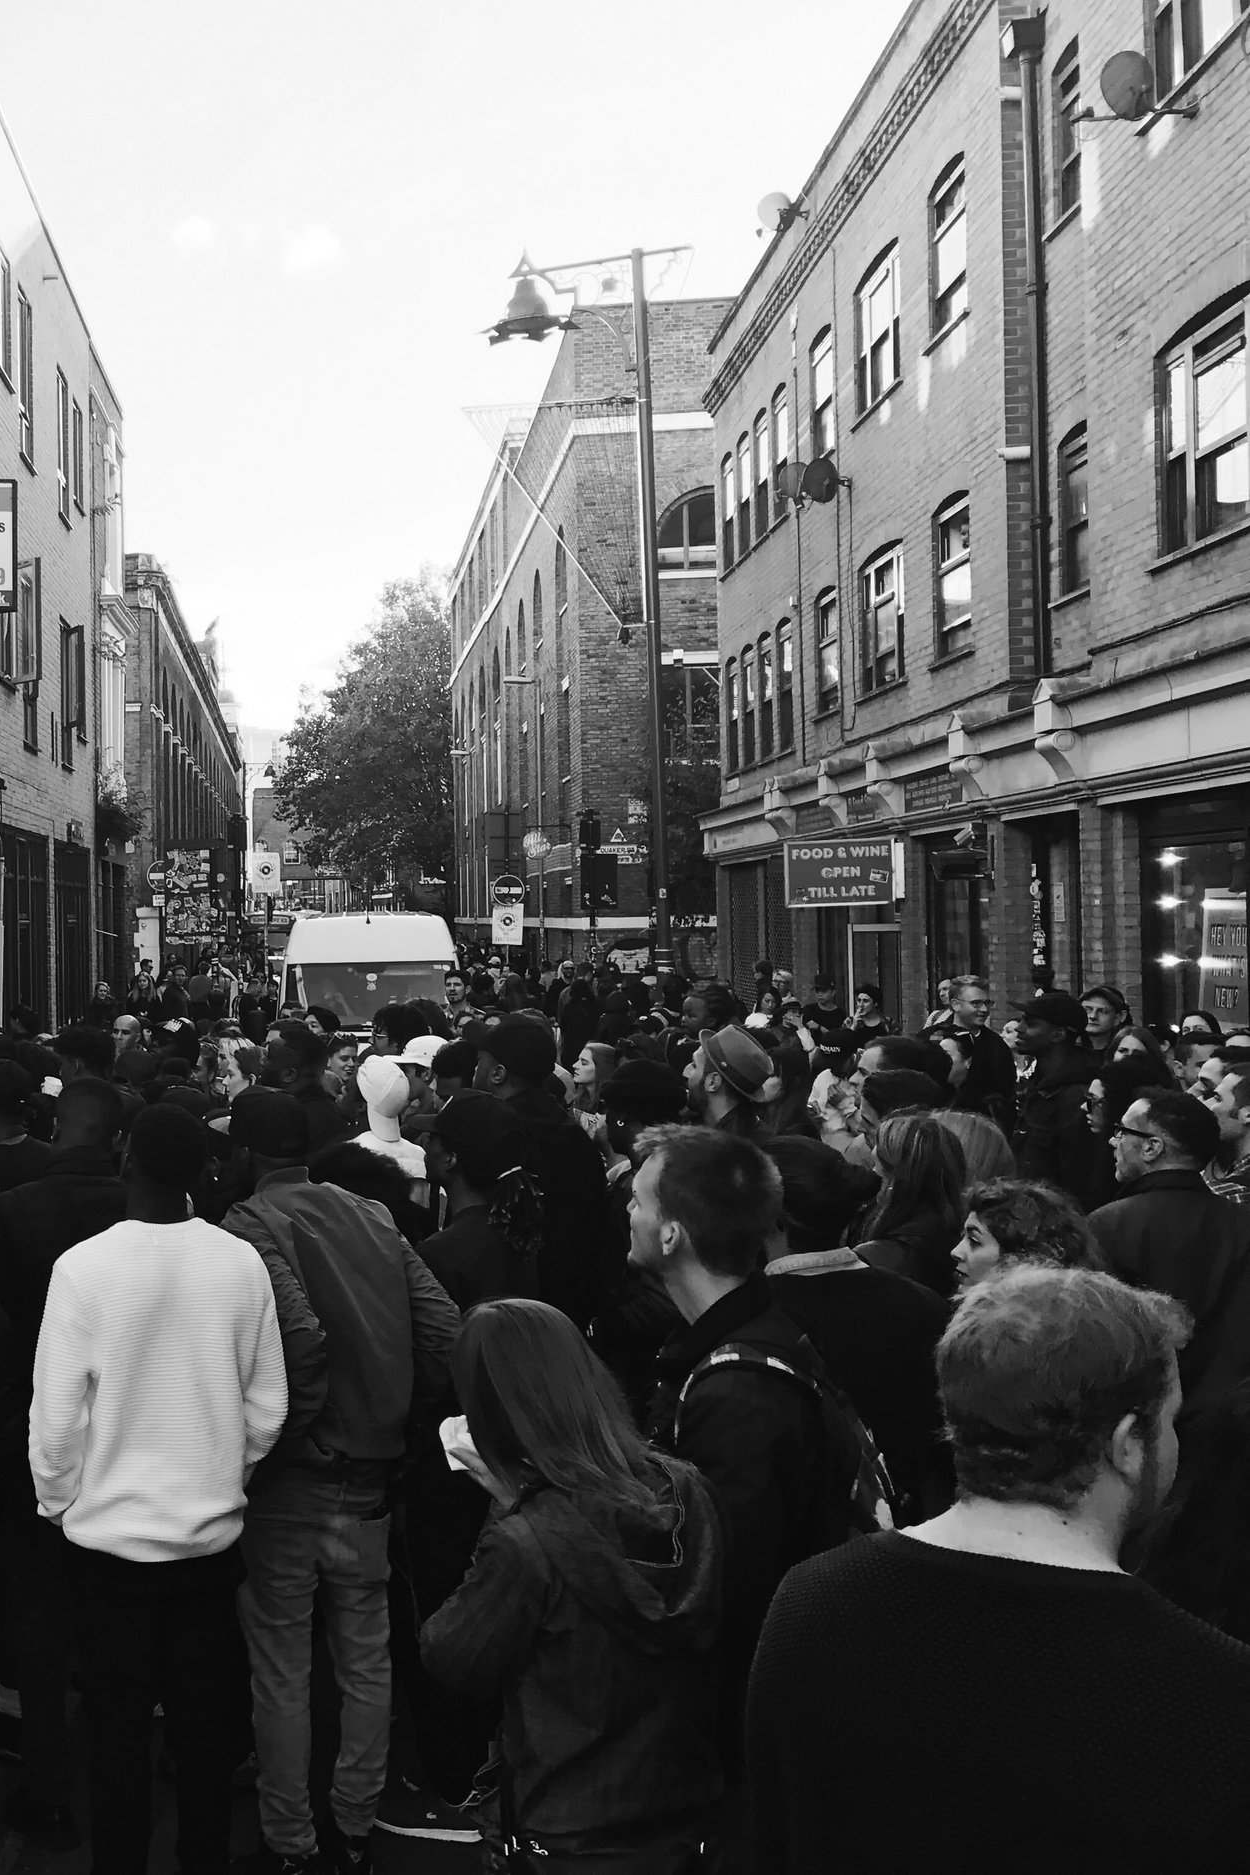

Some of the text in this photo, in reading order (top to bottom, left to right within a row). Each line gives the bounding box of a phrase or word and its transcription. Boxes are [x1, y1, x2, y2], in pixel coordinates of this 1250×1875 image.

[791, 845, 889, 860] FOOD & WINE
[820, 866, 862, 878] OPEN
[807, 885, 877, 898] TILL LATE
[1210, 923, 1248, 948] HEY YOU
[1214, 984, 1240, 1009] NEW?
